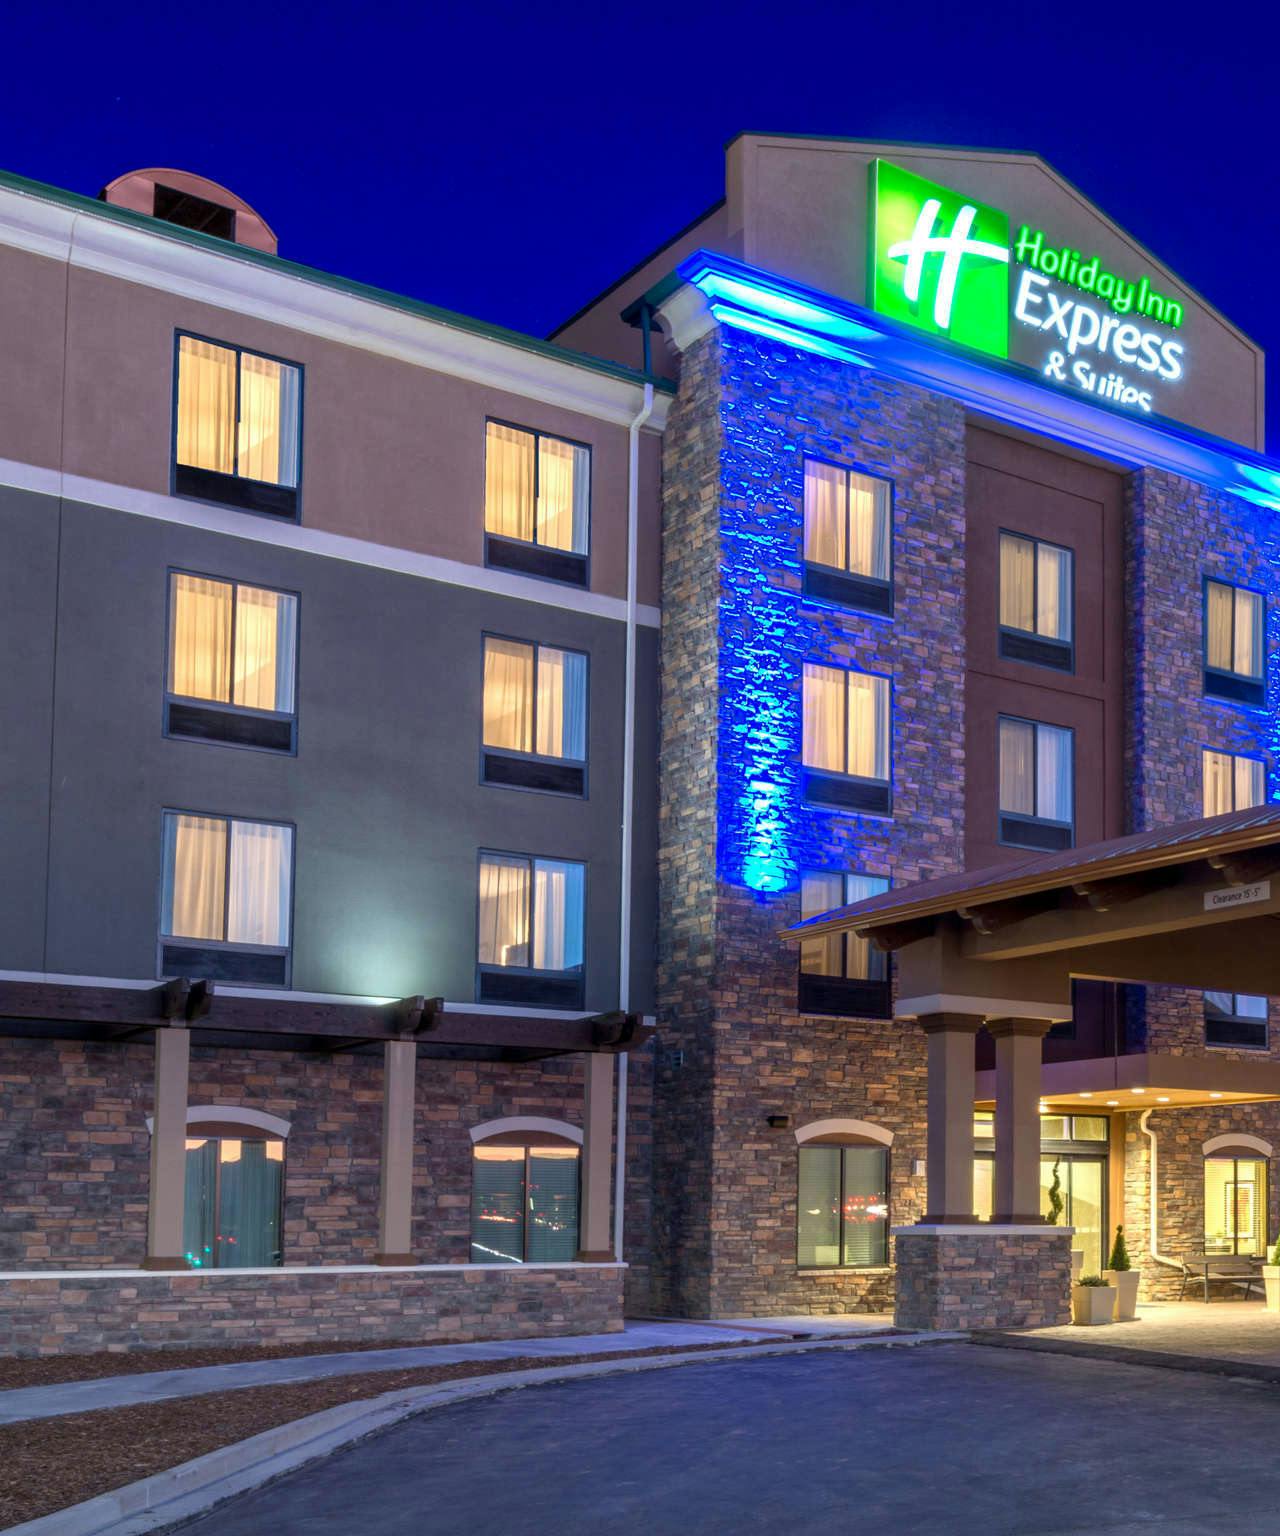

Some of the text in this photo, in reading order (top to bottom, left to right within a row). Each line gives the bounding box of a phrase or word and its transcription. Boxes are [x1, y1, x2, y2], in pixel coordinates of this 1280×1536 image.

[1014, 224, 1184, 328] Holiday Inn
[1014, 269, 1184, 380] Express
[1044, 351, 1067, 381] &
